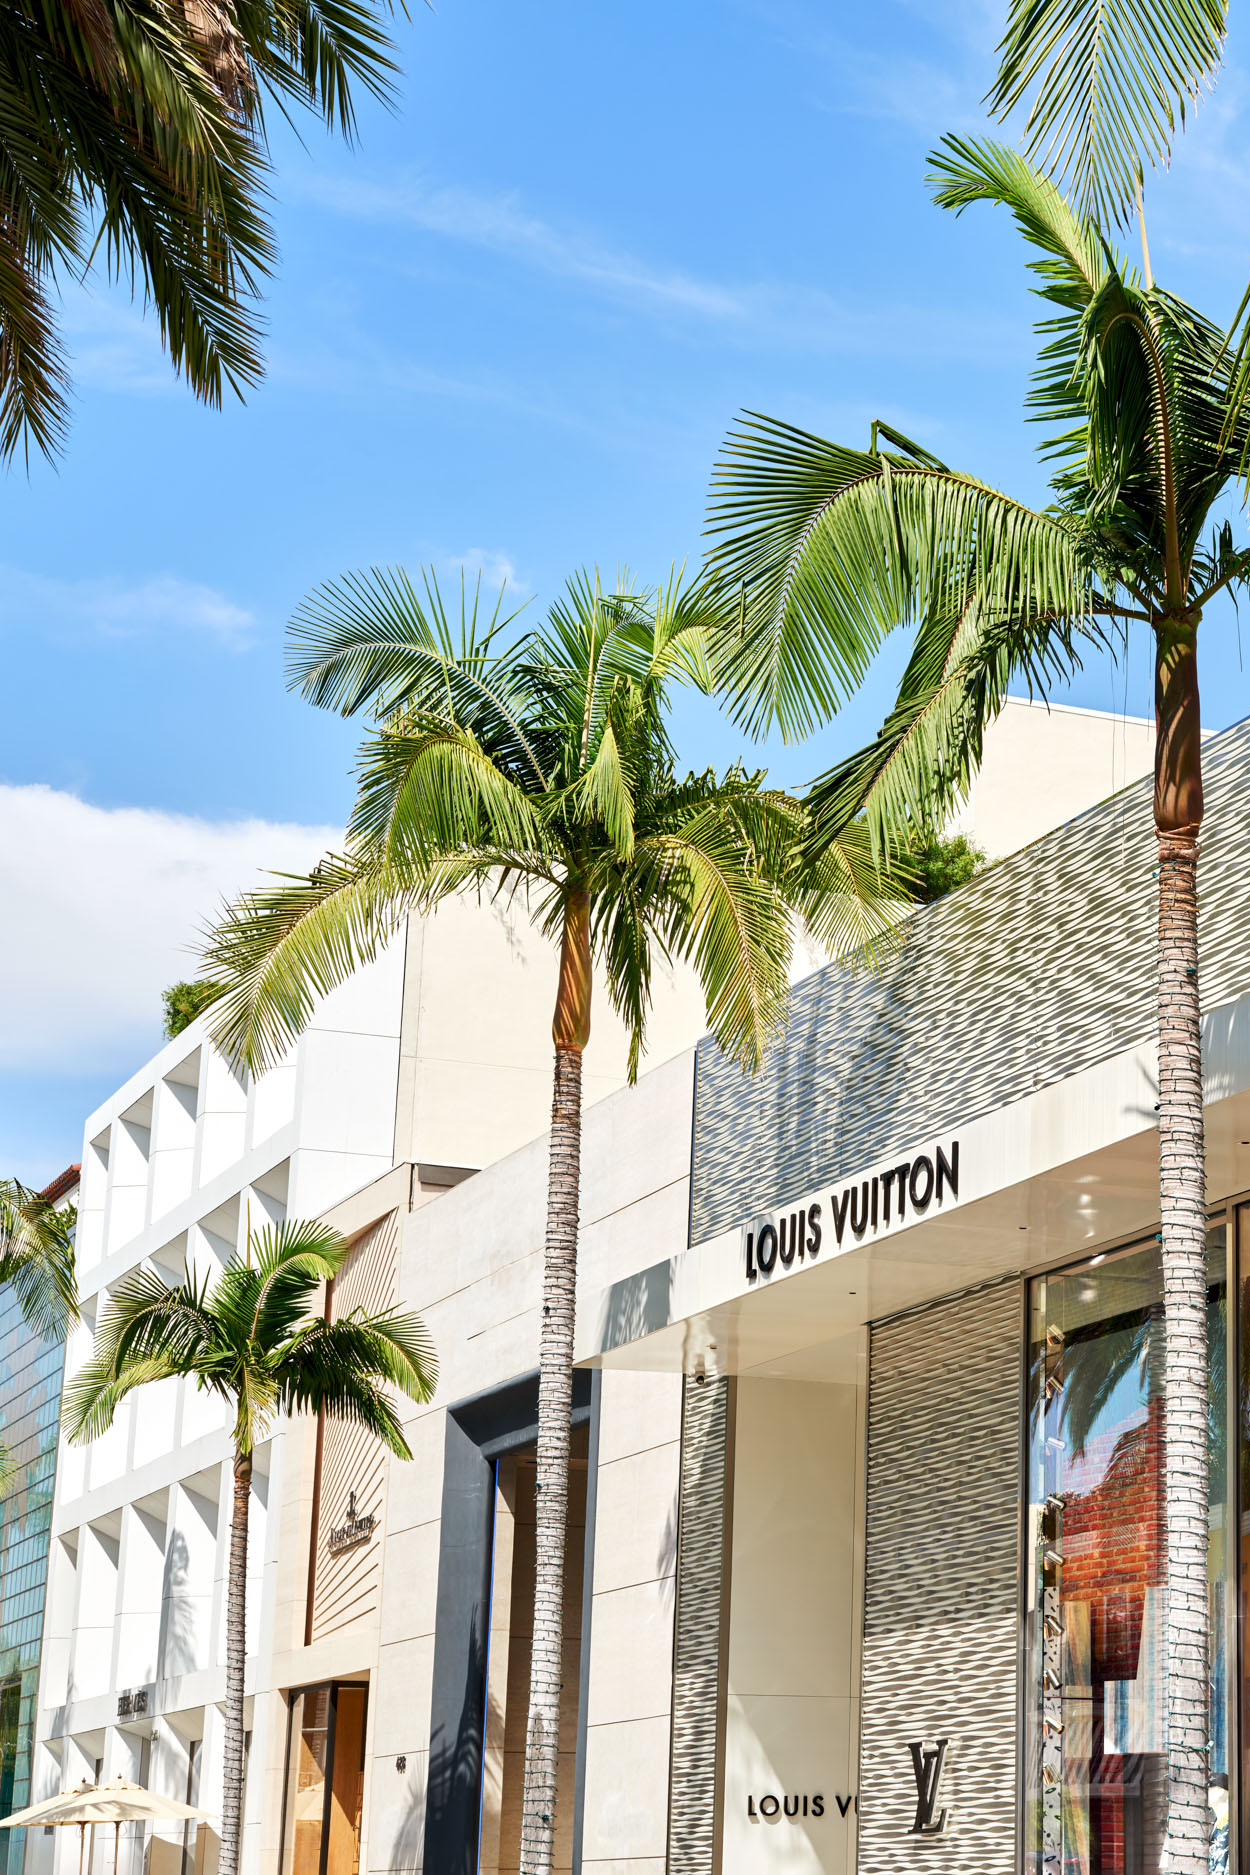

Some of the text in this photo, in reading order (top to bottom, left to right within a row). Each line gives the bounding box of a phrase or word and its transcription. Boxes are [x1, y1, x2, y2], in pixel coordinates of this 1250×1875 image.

[746, 1141, 959, 1279] LOUIS VUITTON
[748, 1795, 825, 1817] LOUIS
